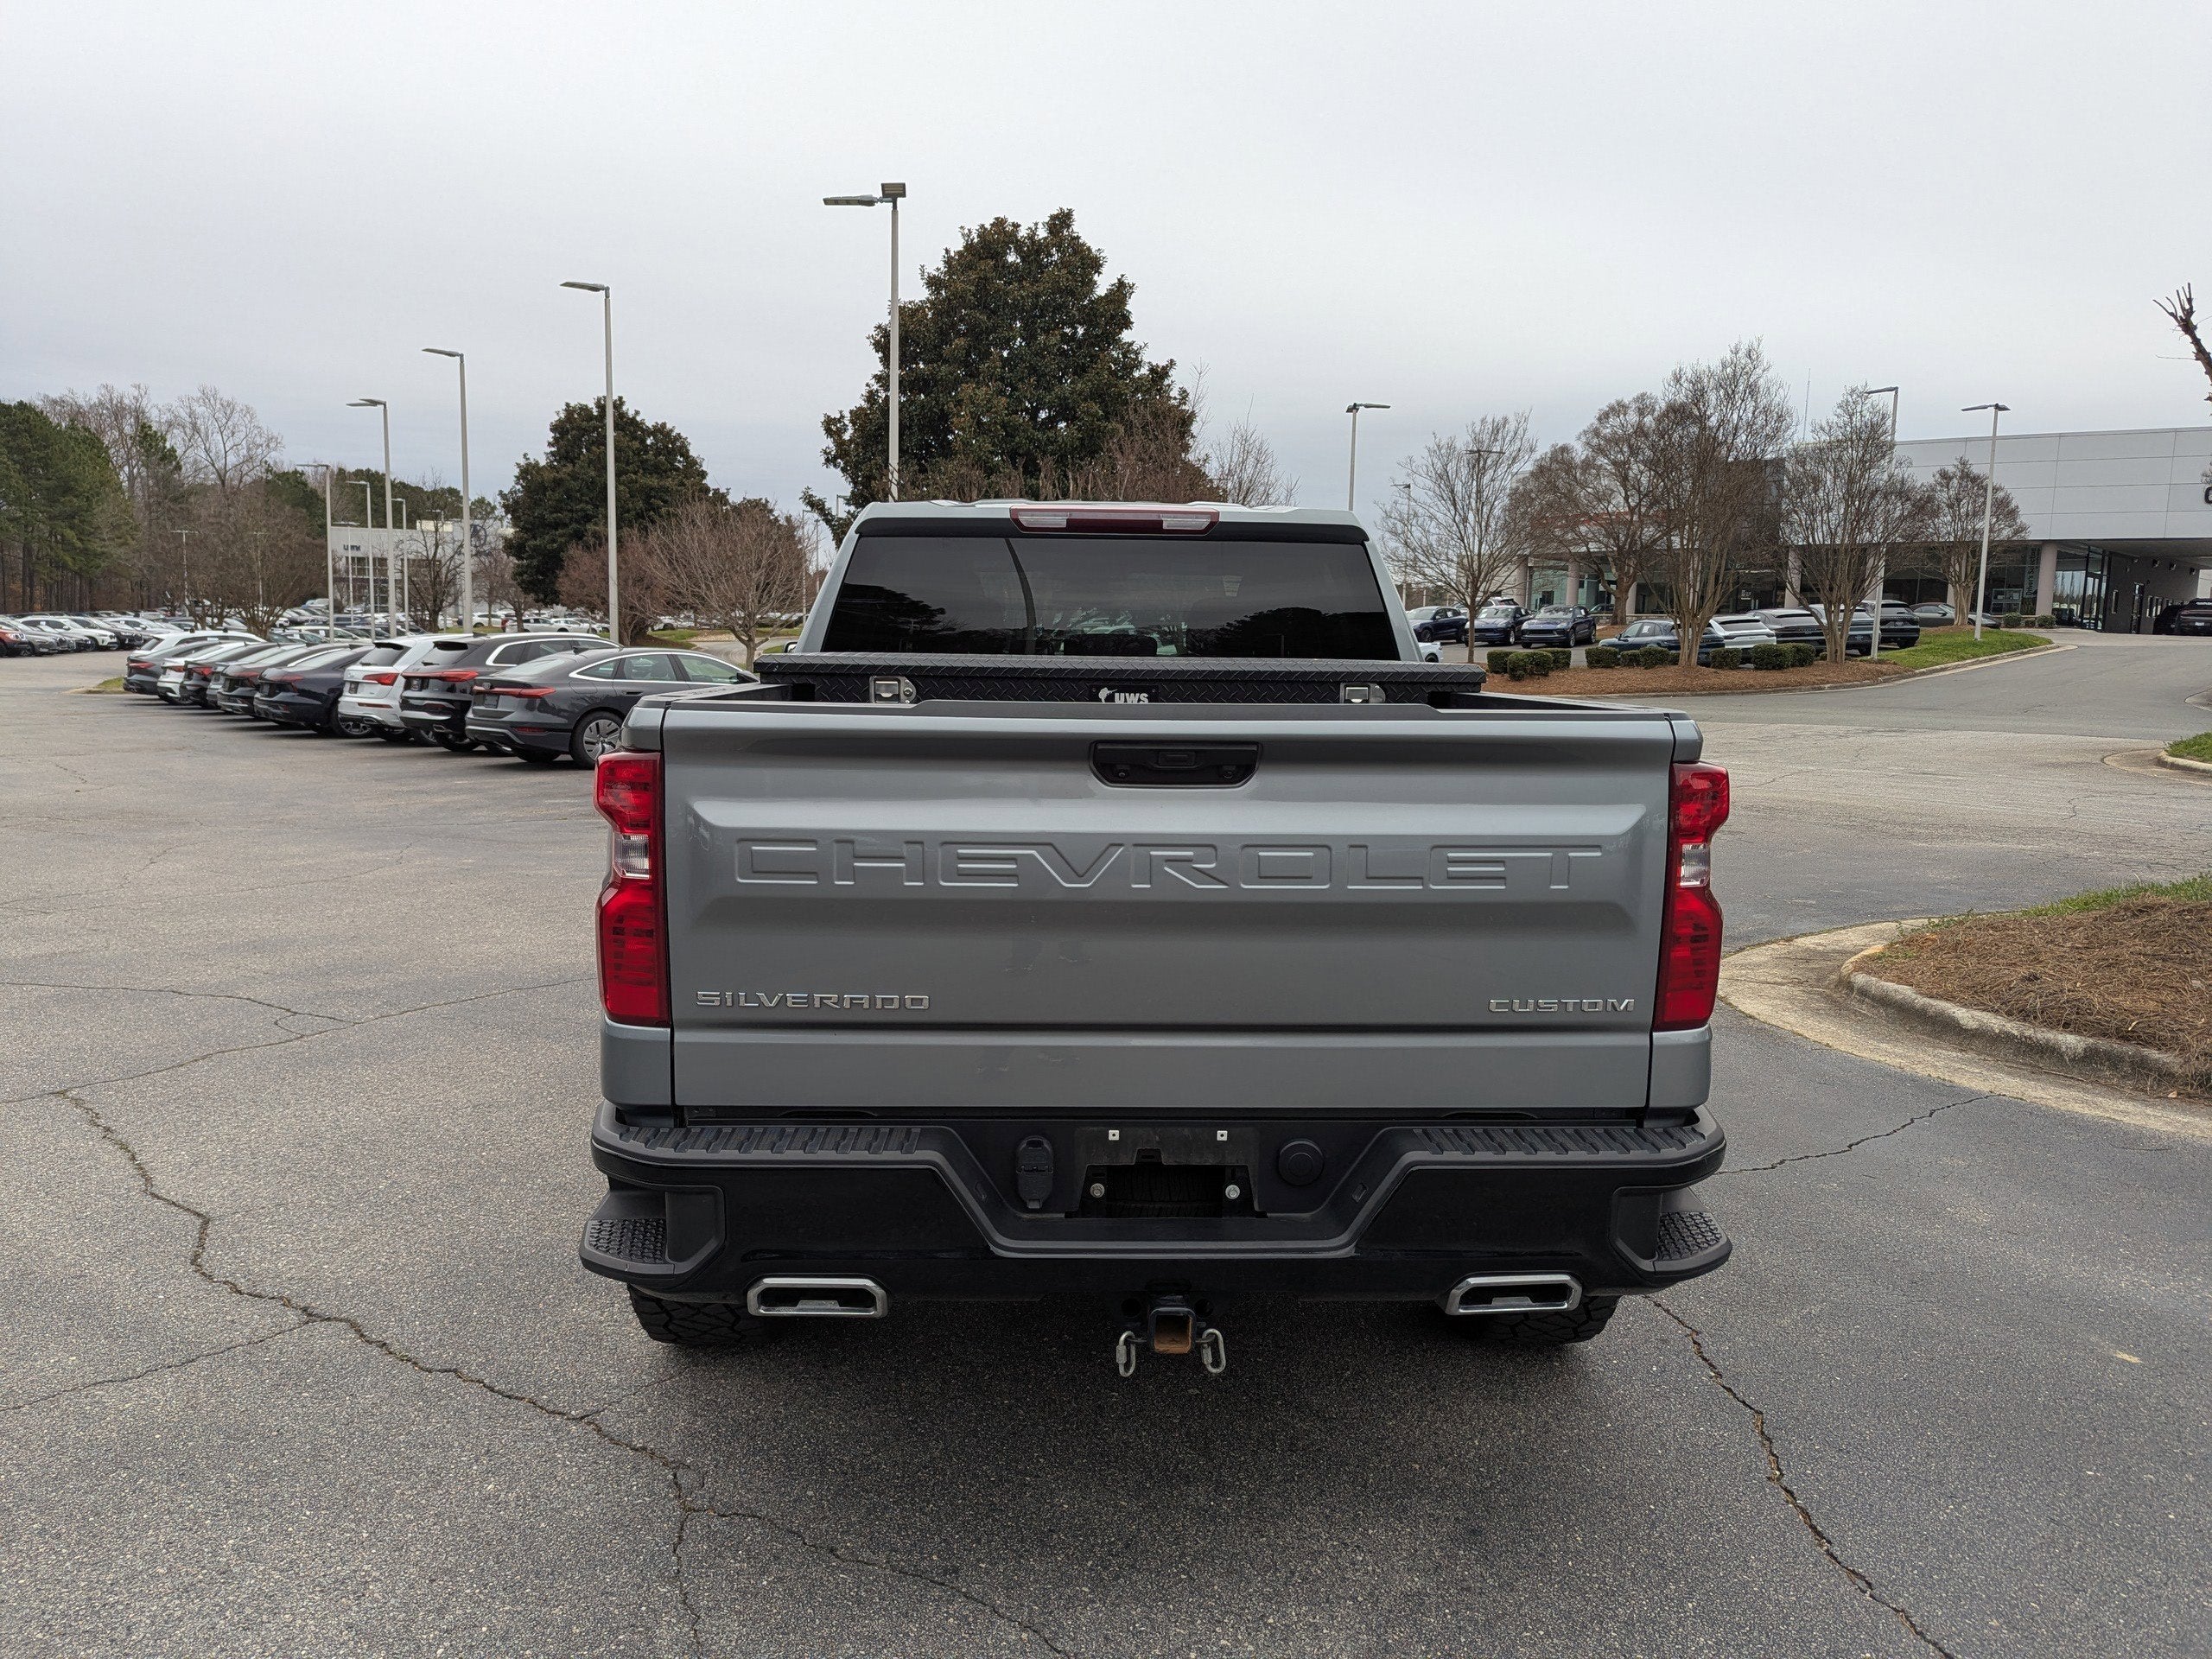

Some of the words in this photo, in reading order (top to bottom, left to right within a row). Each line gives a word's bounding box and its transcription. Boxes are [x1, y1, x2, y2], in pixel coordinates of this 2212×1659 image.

[1114, 692, 1149, 703] UWS
[736, 838, 1603, 890] CHEVROLET
[696, 990, 931, 1010] SILVERADO
[1488, 998, 1636, 1013] CUSTOM
